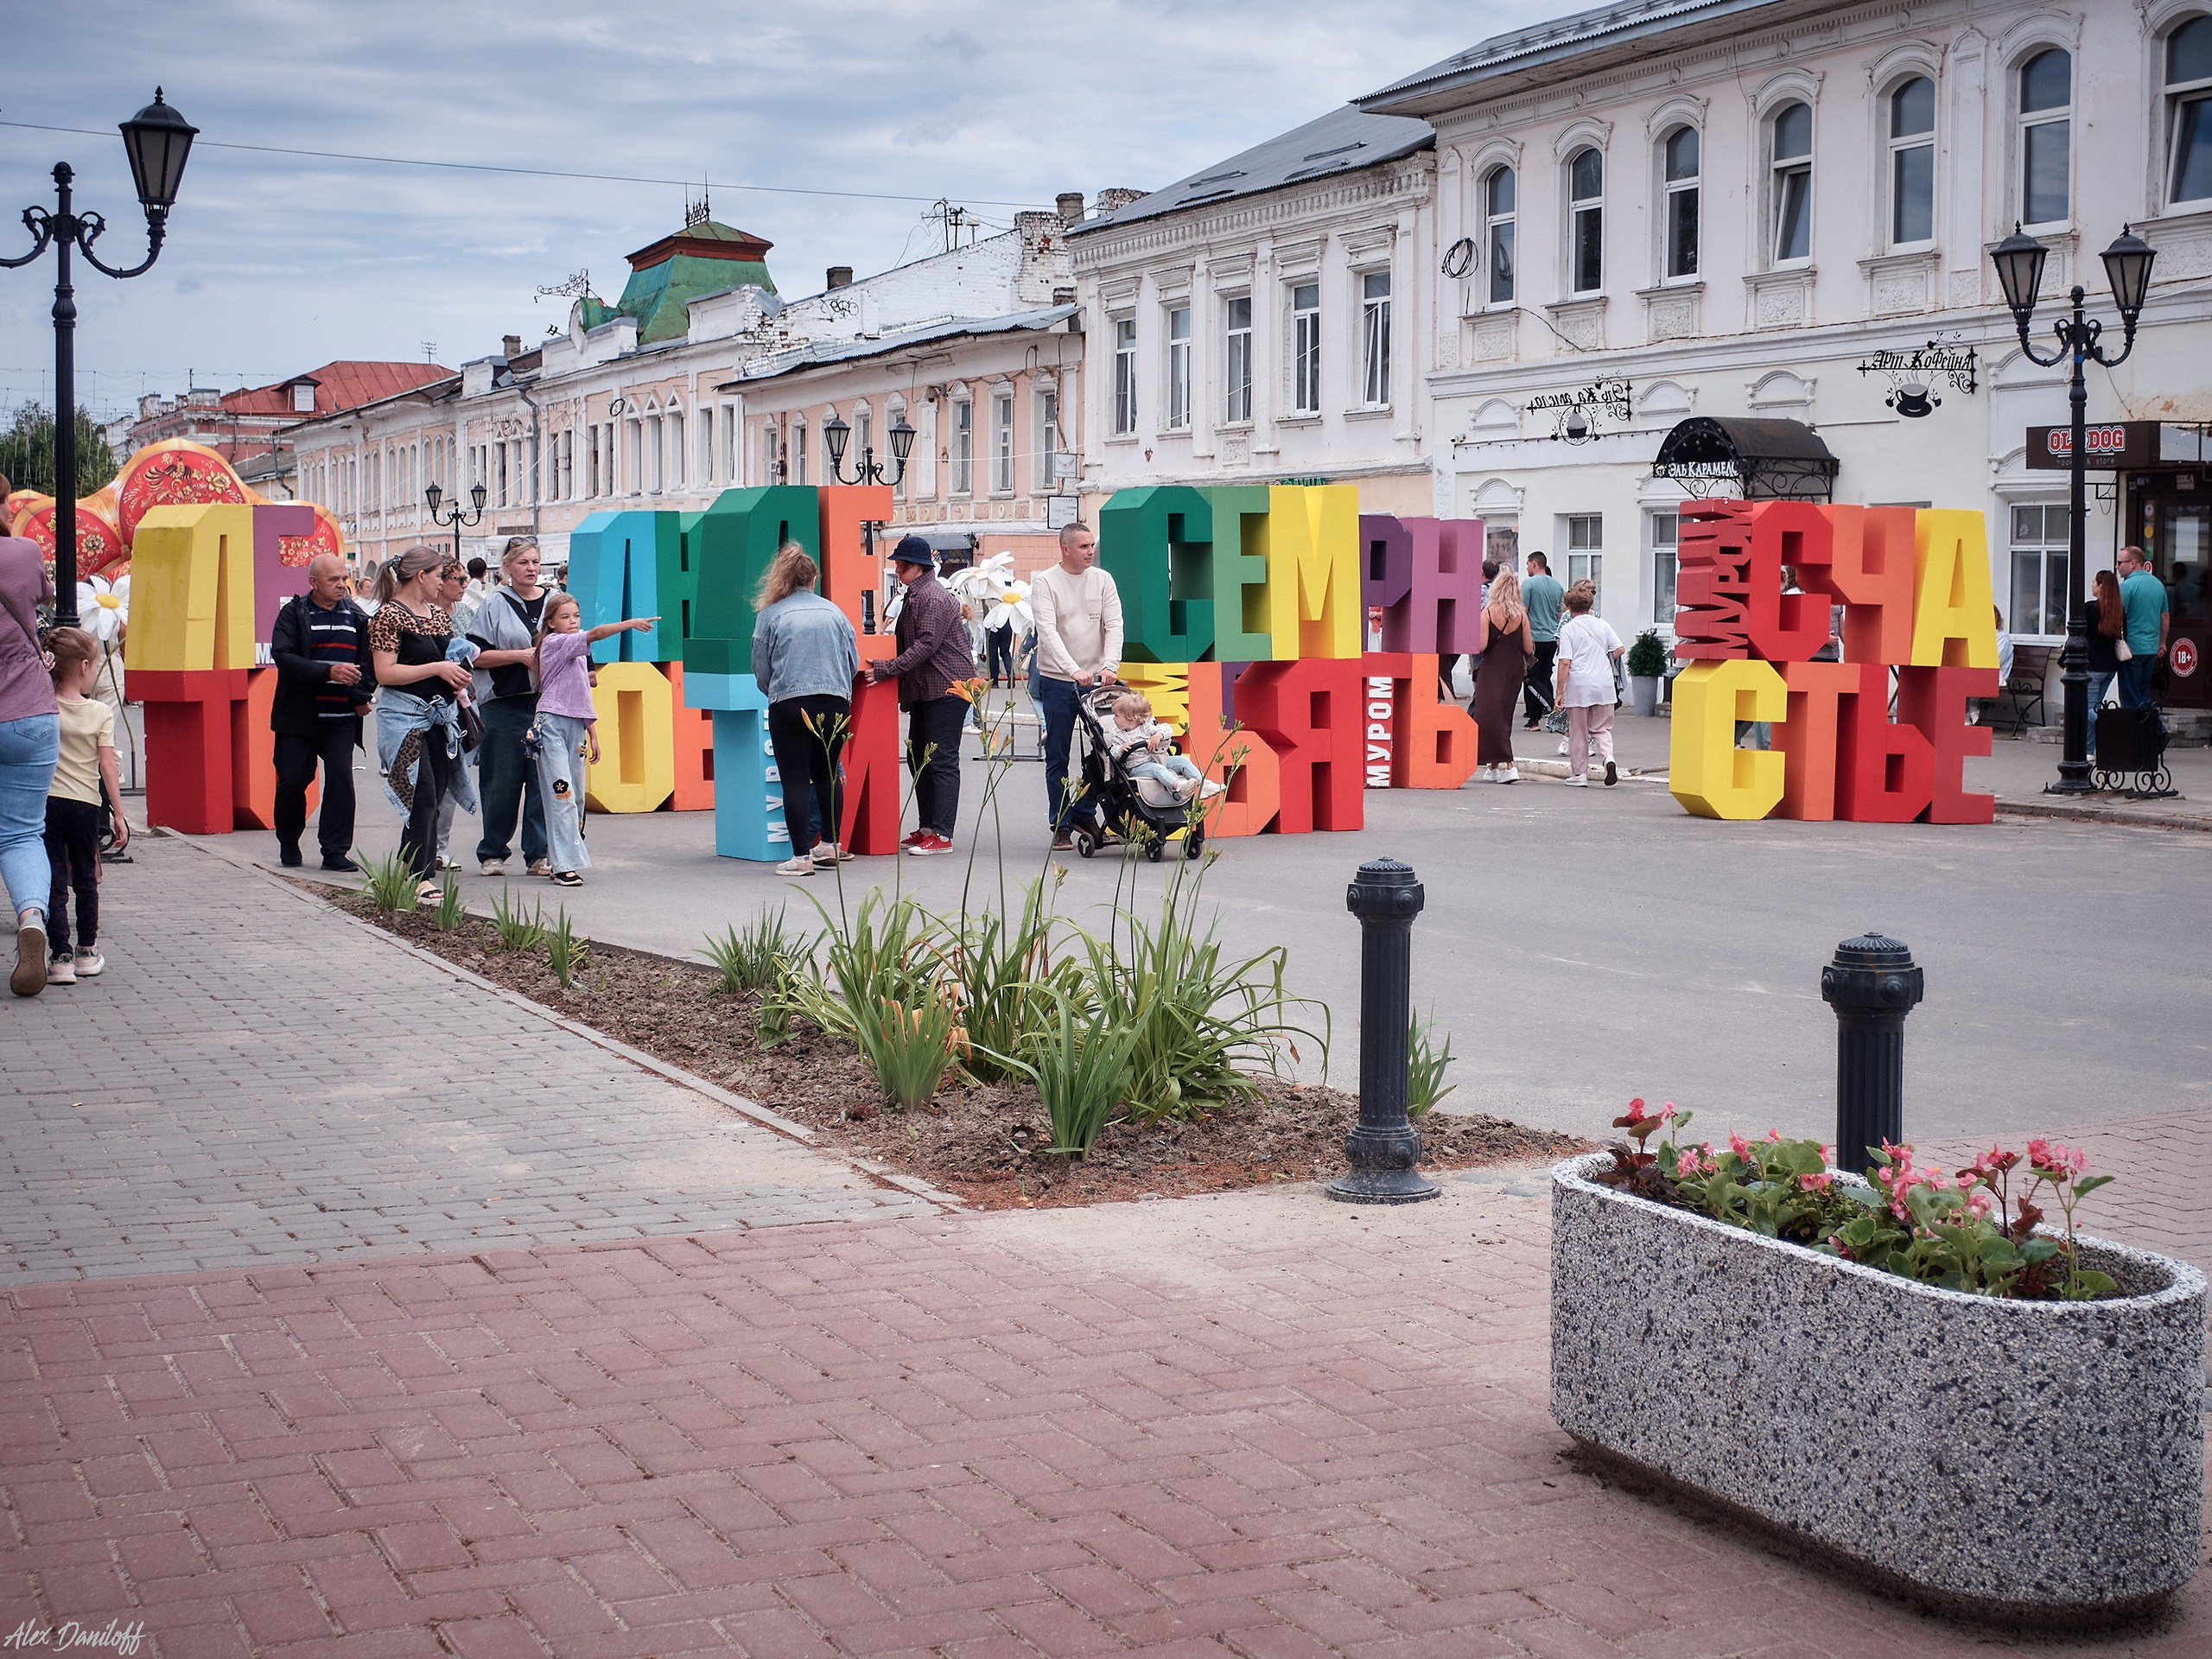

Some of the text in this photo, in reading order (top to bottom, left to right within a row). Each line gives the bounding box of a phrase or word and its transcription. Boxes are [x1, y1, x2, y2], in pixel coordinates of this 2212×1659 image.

[2085, 426, 2126, 453] DOG
[1109, 486, 1359, 663] СЕМ
[1750, 500, 2000, 668] СЧА
[2177, 651, 2192, 664] 18+
[1366, 677, 1393, 788] МУРОМ
[1678, 659, 1999, 824] СТЬЕ
